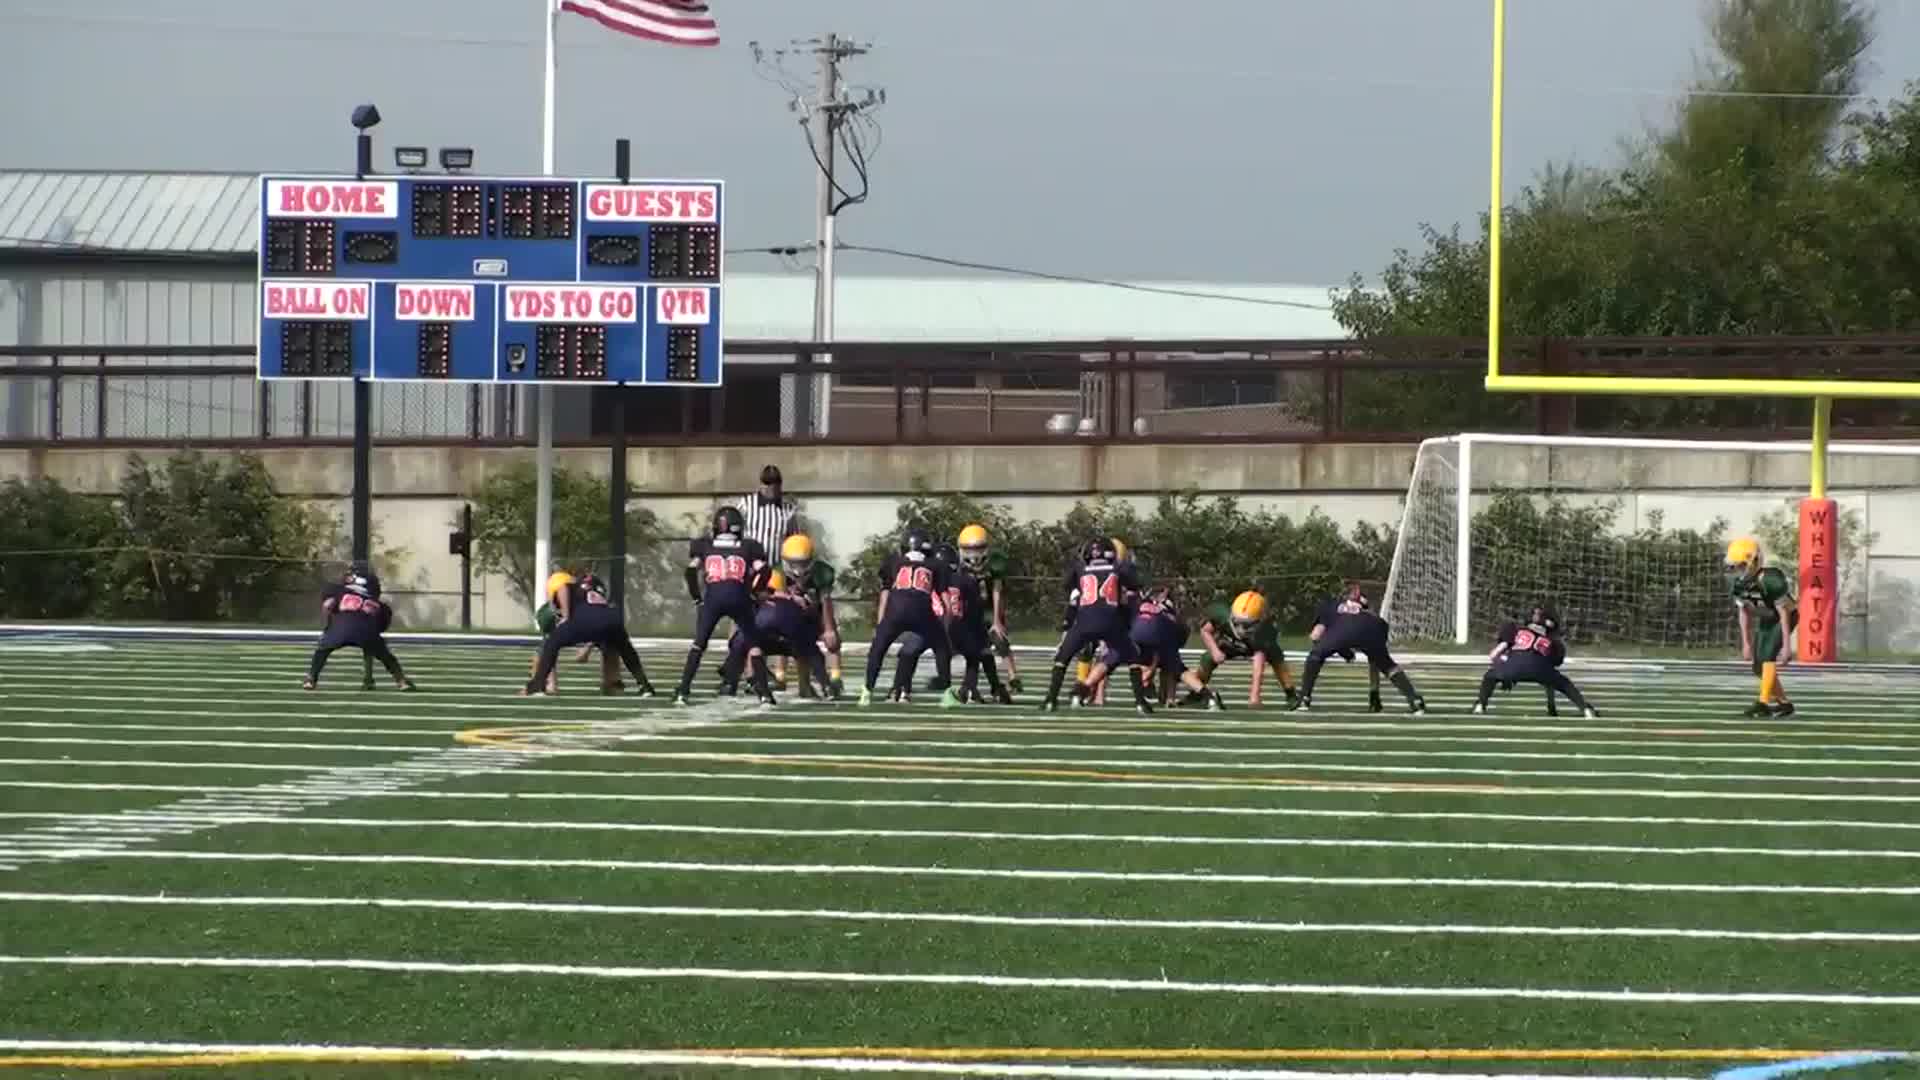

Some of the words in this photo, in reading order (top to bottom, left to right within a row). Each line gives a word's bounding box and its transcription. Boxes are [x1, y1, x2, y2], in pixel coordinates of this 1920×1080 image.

[280, 185, 385, 214] HOME
[589, 190, 714, 219] GUESTS
[267, 287, 327, 315] BALL
[332, 287, 367, 315] ON
[398, 288, 471, 316] DOWN
[510, 290, 557, 319] YDS
[560, 290, 594, 319] TO
[599, 290, 635, 319] GO
[660, 290, 705, 320] QTR
[1808, 510, 1826, 656] WHEATON
